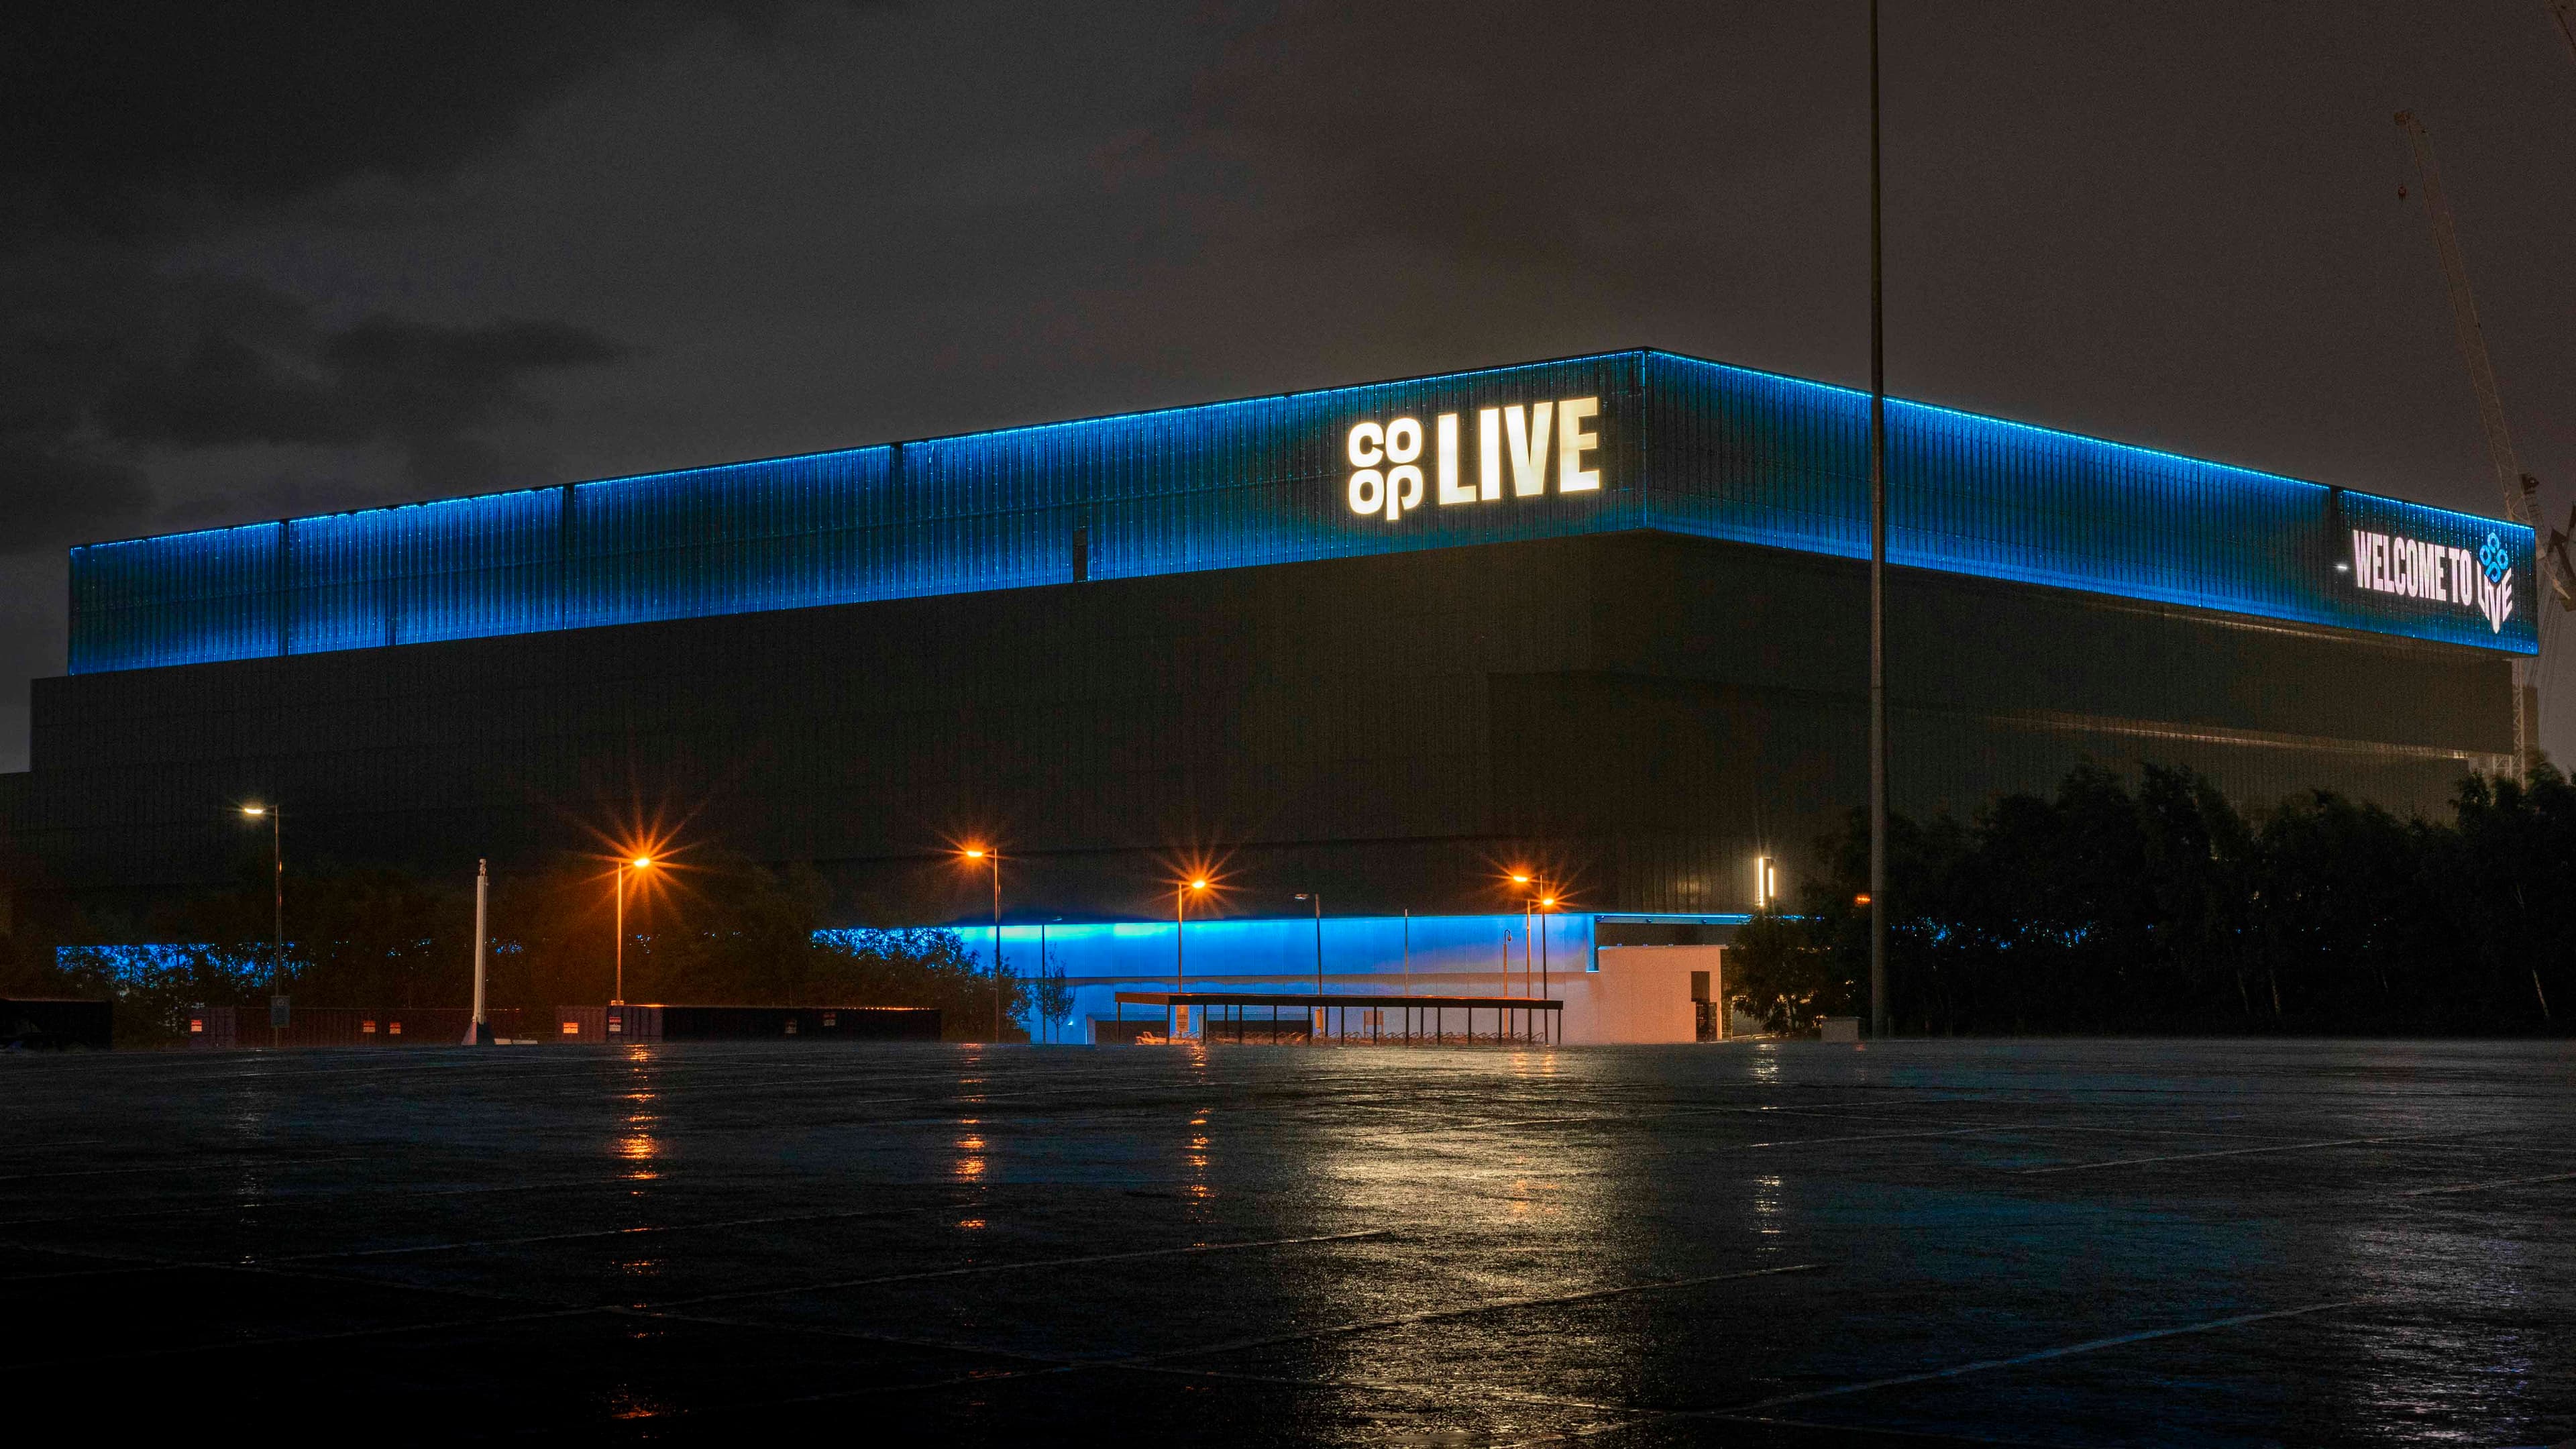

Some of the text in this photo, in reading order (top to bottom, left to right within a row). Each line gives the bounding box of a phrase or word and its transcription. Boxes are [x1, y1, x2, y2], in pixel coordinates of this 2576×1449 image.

[1438, 396, 1600, 505] LIVE
[2353, 529, 2473, 606] WELCOME TO
[2476, 559, 2513, 634] LIVE
